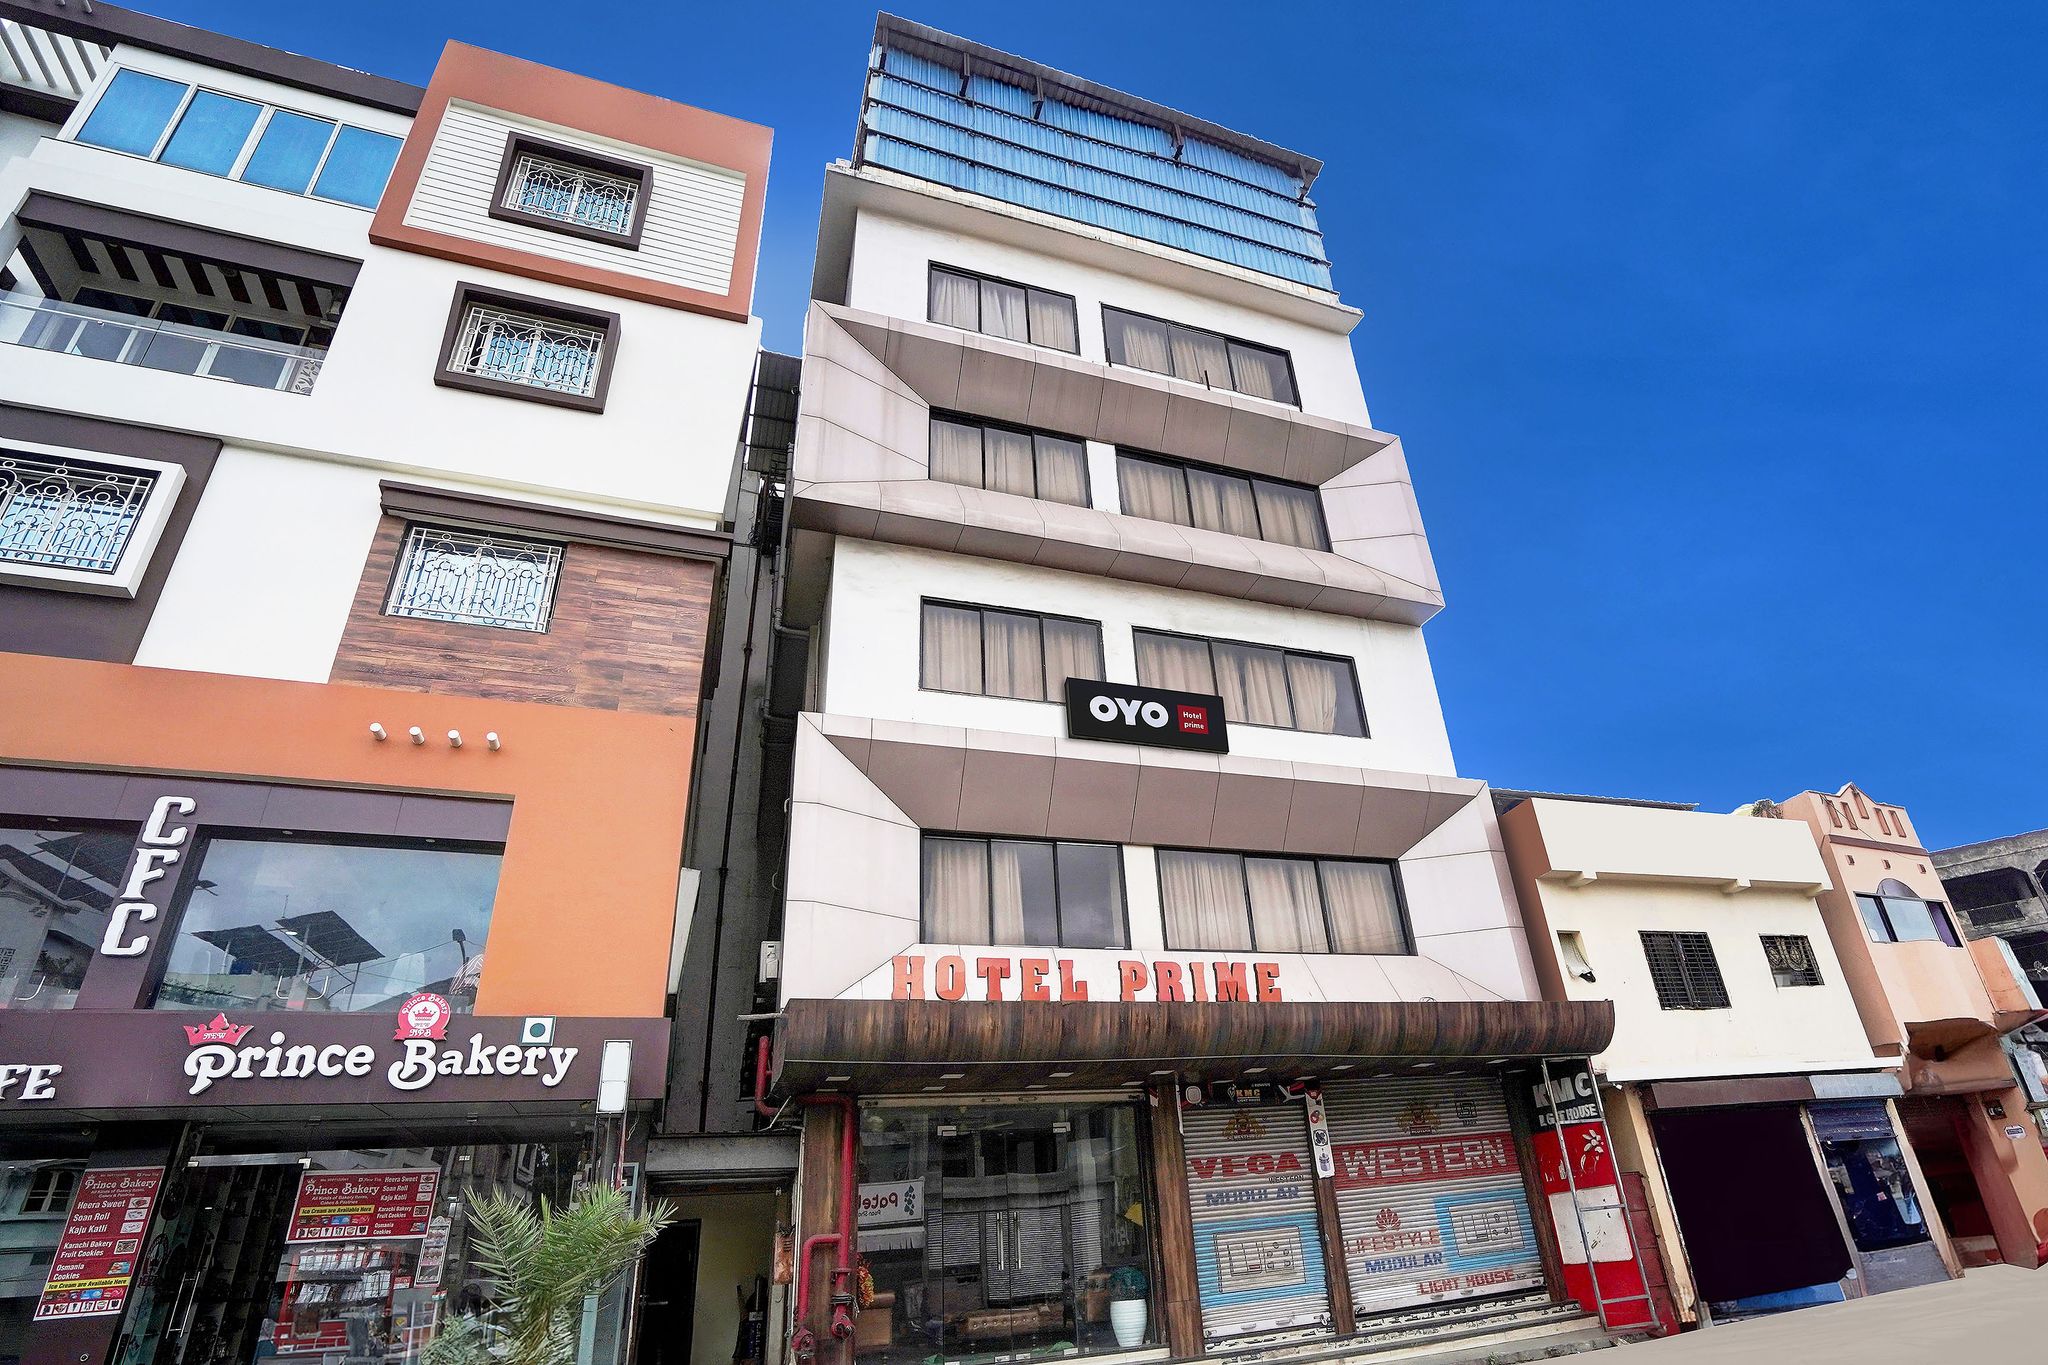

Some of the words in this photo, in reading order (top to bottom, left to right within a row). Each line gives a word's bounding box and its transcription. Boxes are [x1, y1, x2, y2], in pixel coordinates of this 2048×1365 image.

[1089, 695, 1169, 728] OYO
[1183, 711, 1202, 720] Hotel
[1184, 722, 1204, 730] prime
[101, 796, 196, 957] CFC
[891, 955, 1088, 1002] HOTEL
[1118, 960, 1282, 1003] PRIME
[184, 1031, 375, 1095] Prince
[387, 1033, 579, 1091] Bakery
[1532, 1072, 1593, 1108] KMC
[1566, 1104, 1598, 1120] HOUSE
[1190, 1152, 1302, 1179] VEGA
[1342, 1138, 1507, 1179] WESTERN
[85, 1179, 117, 1190] Prince
[120, 1178, 156, 1188] Bakery
[305, 1184, 338, 1196] Prince
[342, 1182, 380, 1196] Bakery
[78, 1202, 100, 1210] Heera
[102, 1200, 126, 1208] Sweet
[72, 1214, 92, 1222] Soan
[94, 1212, 110, 1220] Roll
[68, 1226, 87, 1235] Kaju
[88, 1224, 108, 1233] Katli
[90, 1240, 113, 1248] Bakery
[1344, 1228, 1440, 1254] LIFESTYLE
[56, 1263, 84, 1271] Osmania
[1365, 1252, 1443, 1274] MODULAR
[1418, 1277, 1459, 1296] LIGHT
[1466, 1269, 1514, 1288] HOUSE
